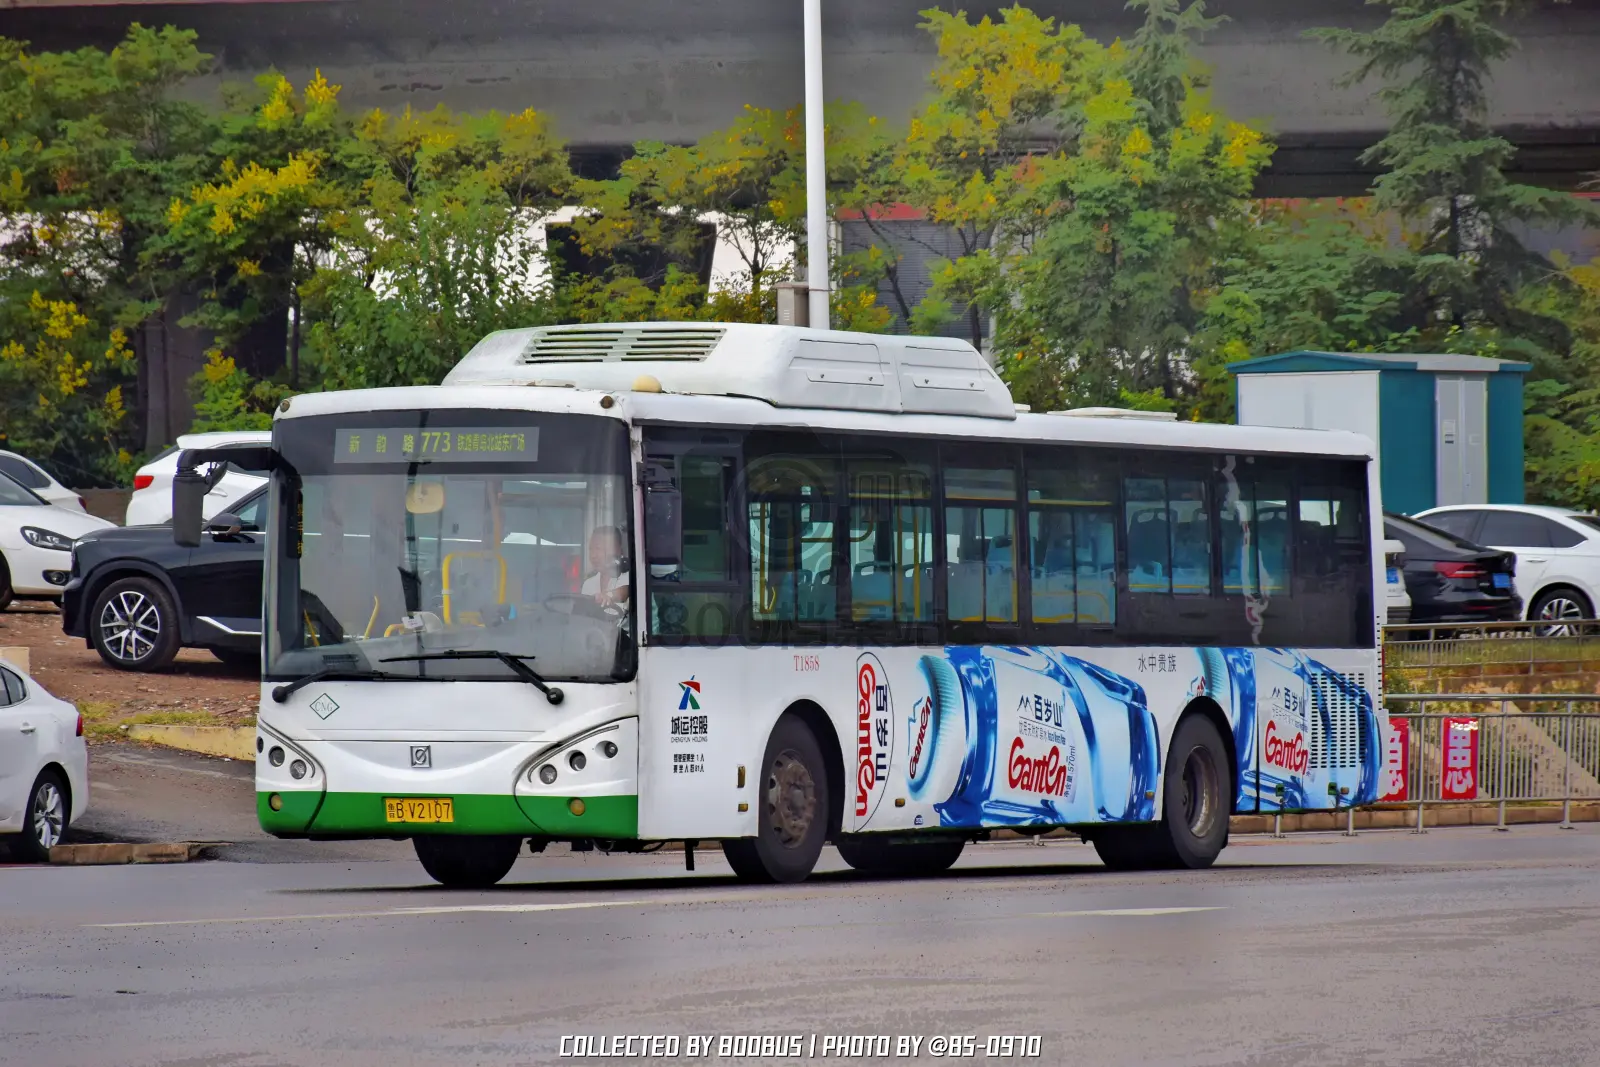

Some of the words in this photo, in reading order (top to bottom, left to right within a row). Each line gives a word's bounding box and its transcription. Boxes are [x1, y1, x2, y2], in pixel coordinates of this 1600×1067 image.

[421, 431, 452, 453] 773
[793, 655, 820, 672] T1858
[1137, 652, 1177, 673] 水中贵族
[1033, 693, 1063, 728] 百岁山
[1284, 686, 1306, 718] 百岁山
[670, 715, 708, 735] 城运控股
[855, 662, 876, 817] Ganten
[875, 683, 889, 782] 百岁山
[1067, 745, 1077, 772] 570ml
[1264, 719, 1309, 776] Ganten
[1008, 736, 1067, 798] Ganten
